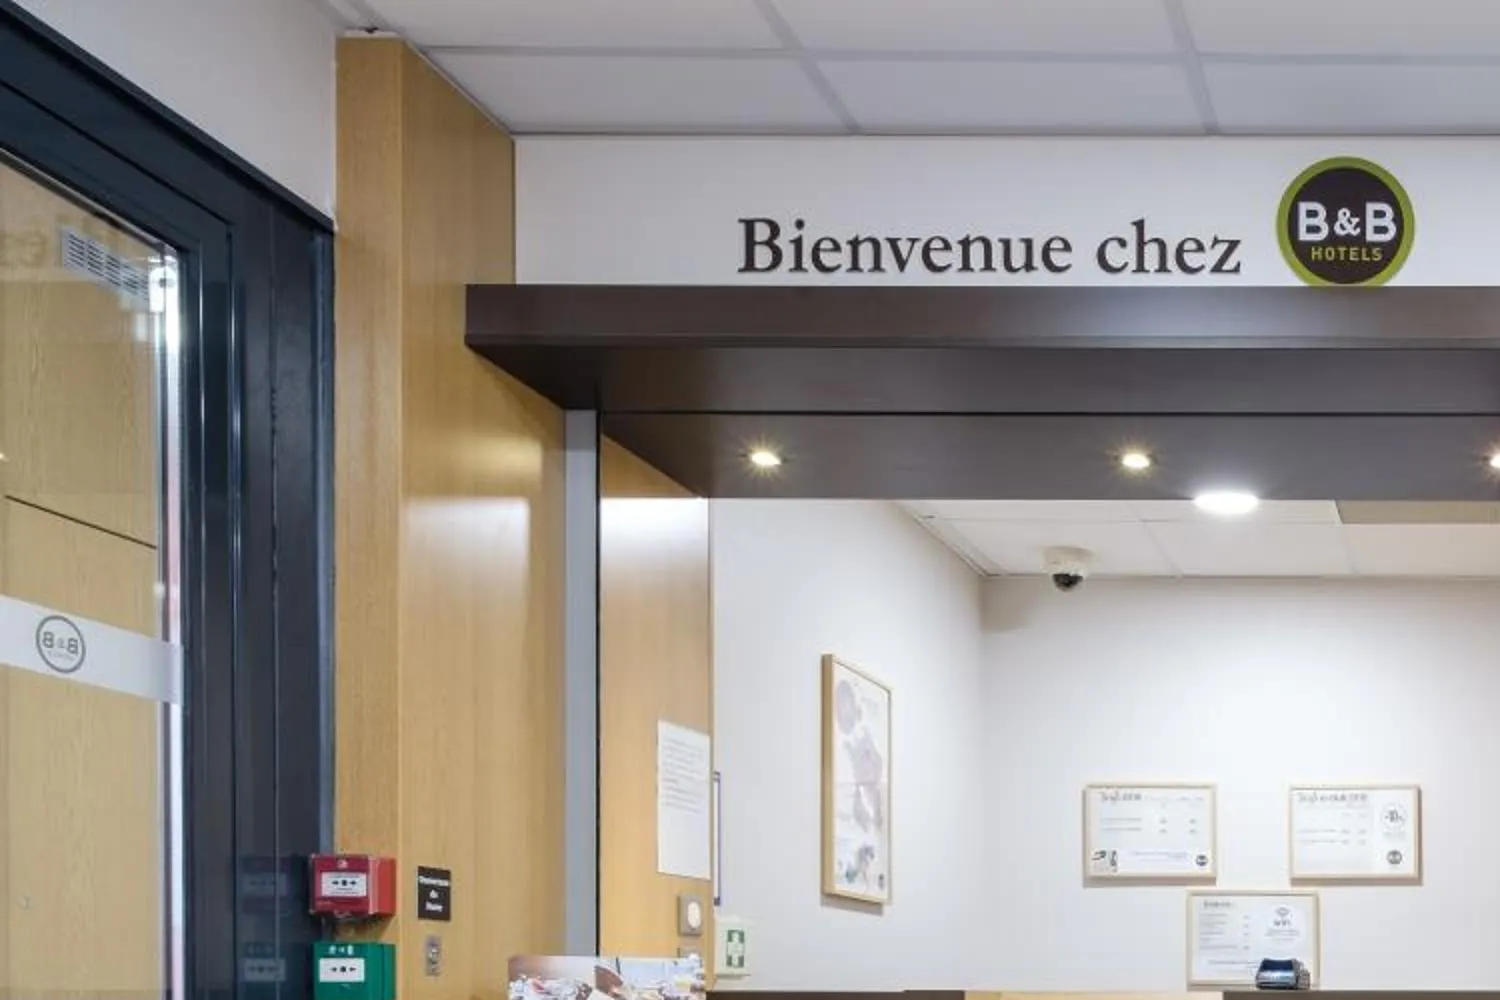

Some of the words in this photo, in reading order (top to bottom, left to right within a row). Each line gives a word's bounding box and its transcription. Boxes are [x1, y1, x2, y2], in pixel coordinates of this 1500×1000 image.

[1297, 202, 1397, 242] B&B
[737, 217, 1073, 273] Bienvenue
[1096, 219, 1241, 274] chez
[1310, 247, 1384, 262] HOTELS
